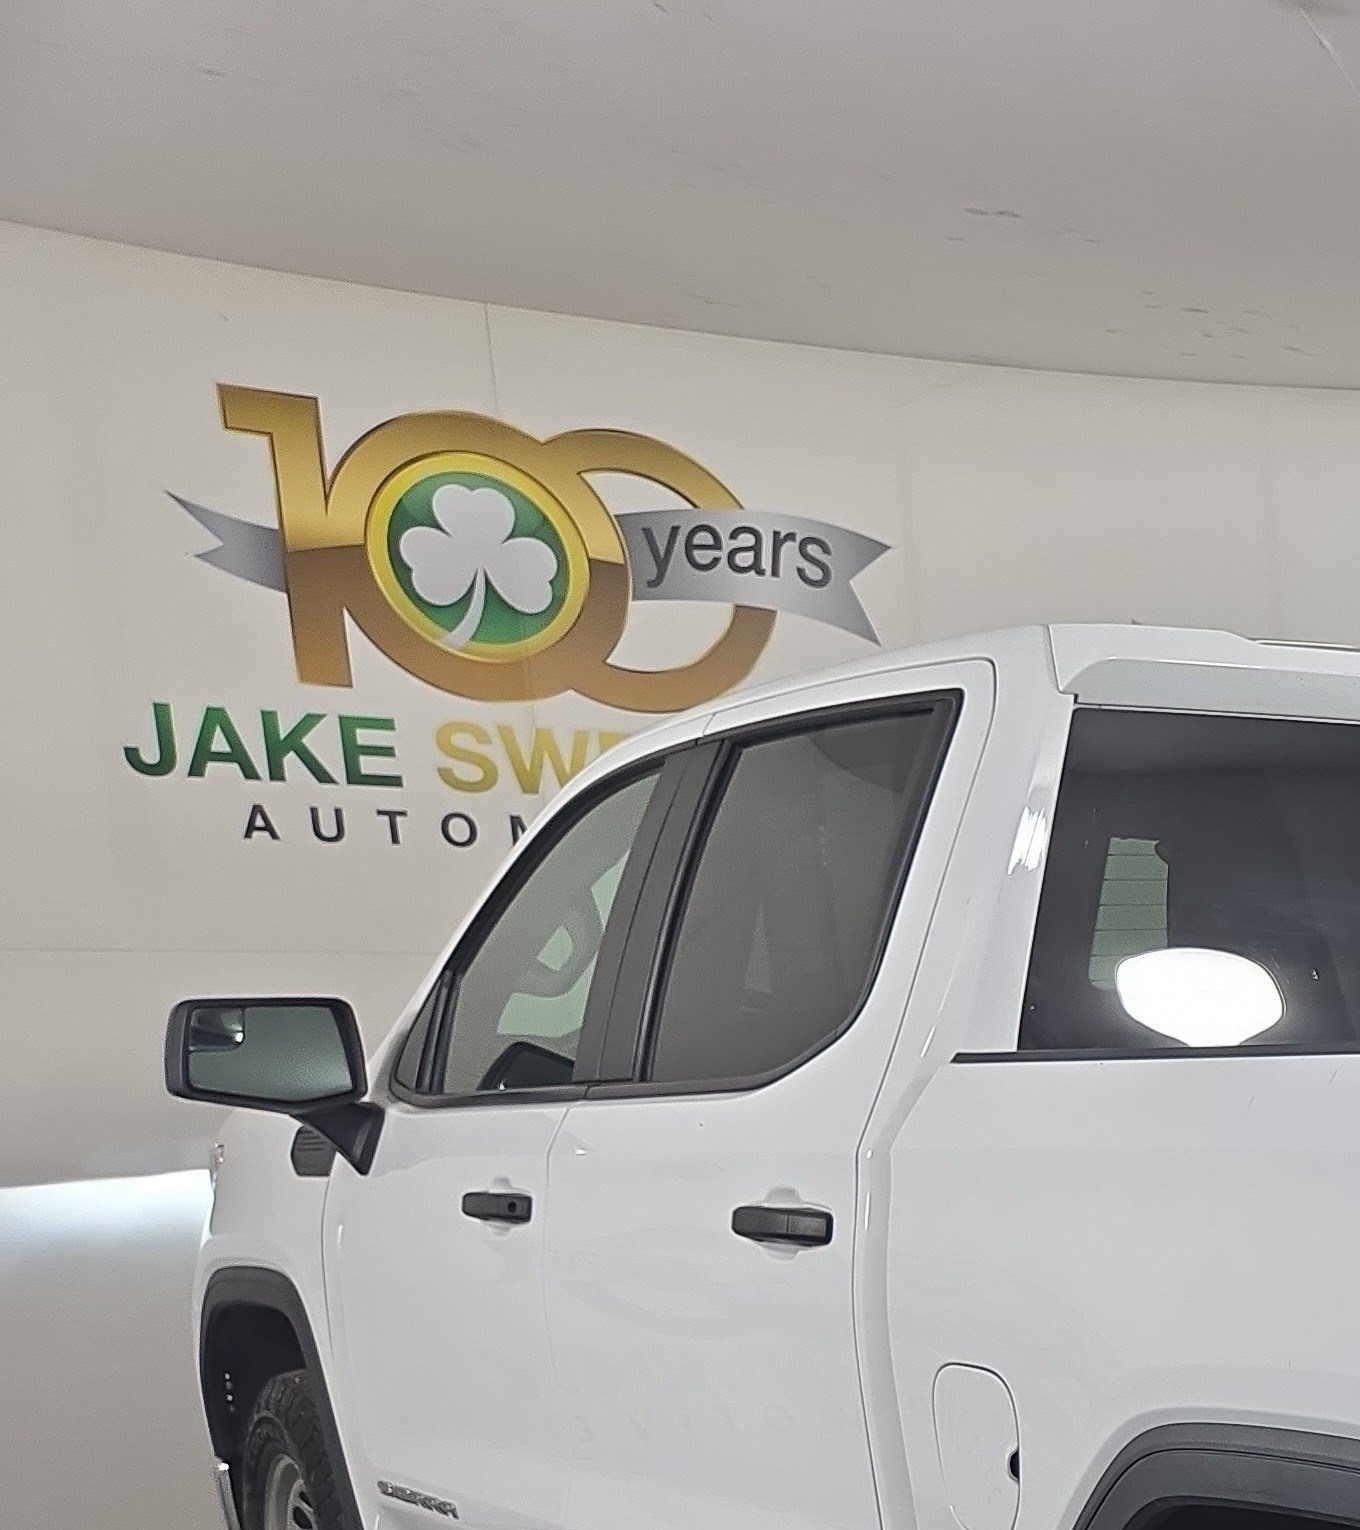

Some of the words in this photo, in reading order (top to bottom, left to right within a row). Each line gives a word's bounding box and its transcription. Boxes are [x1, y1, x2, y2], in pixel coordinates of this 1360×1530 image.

[642, 522, 834, 590] years
[123, 702, 404, 788] JAKE
[435, 721, 632, 794] SW
